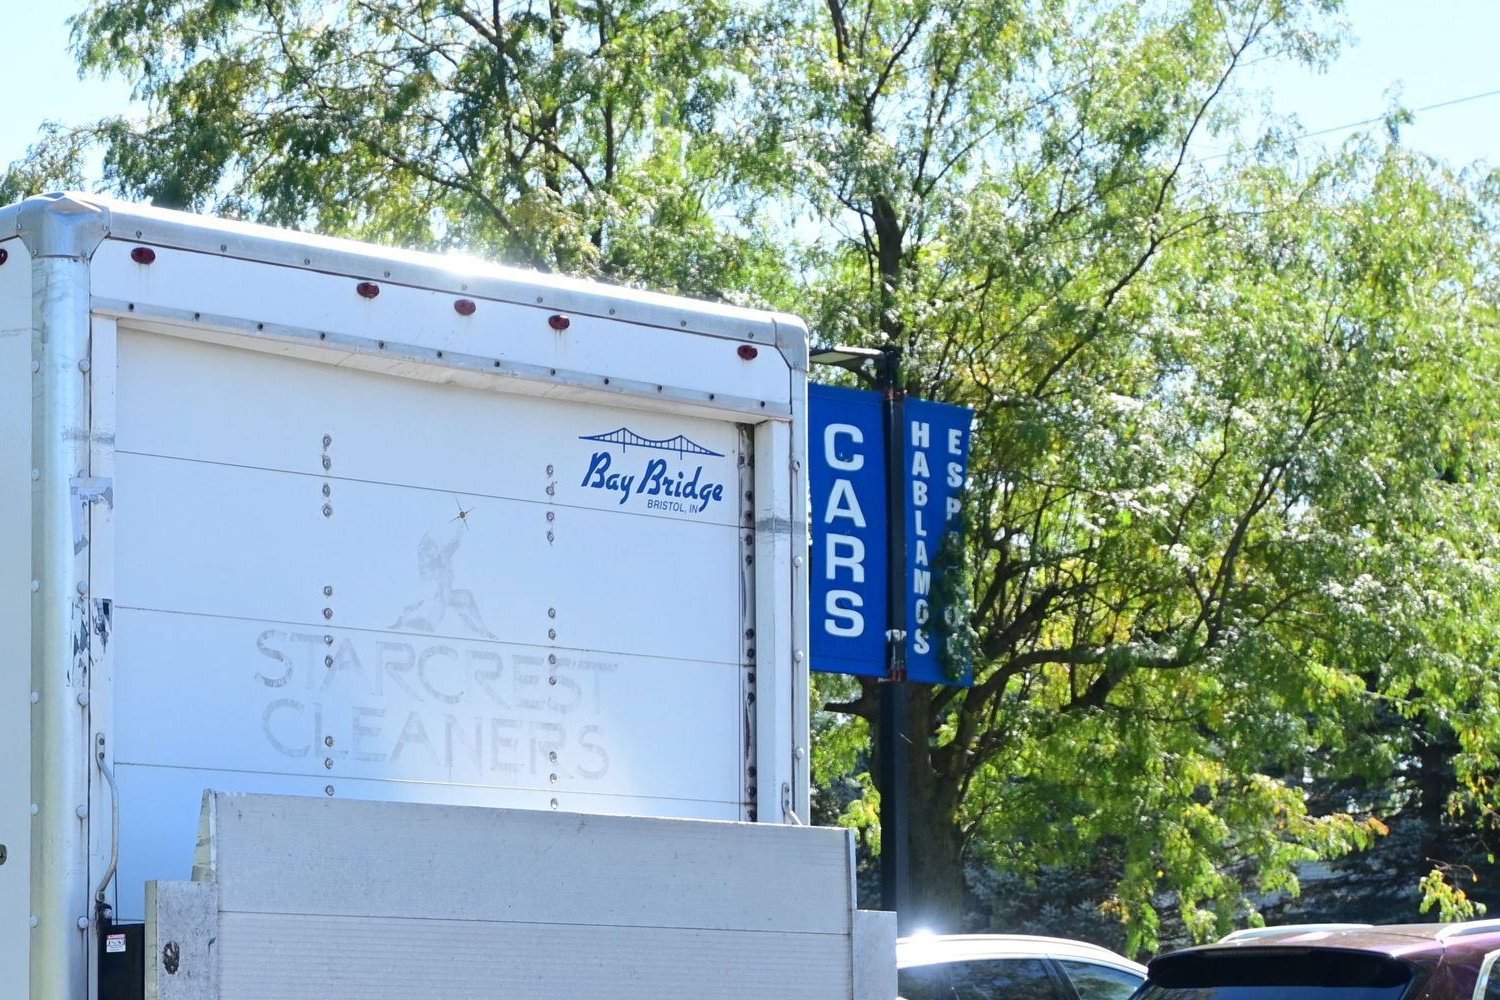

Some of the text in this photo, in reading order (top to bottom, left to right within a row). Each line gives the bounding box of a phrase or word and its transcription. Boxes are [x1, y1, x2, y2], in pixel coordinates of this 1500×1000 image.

[581, 451, 724, 513] Bay Bridge
[647, 499, 699, 515] BRISTOL, IN
[823, 423, 867, 638] CARS
[911, 421, 931, 654] HABLAMOS
[255, 629, 618, 716] STARCREST
[262, 698, 610, 780] CLEANERS
